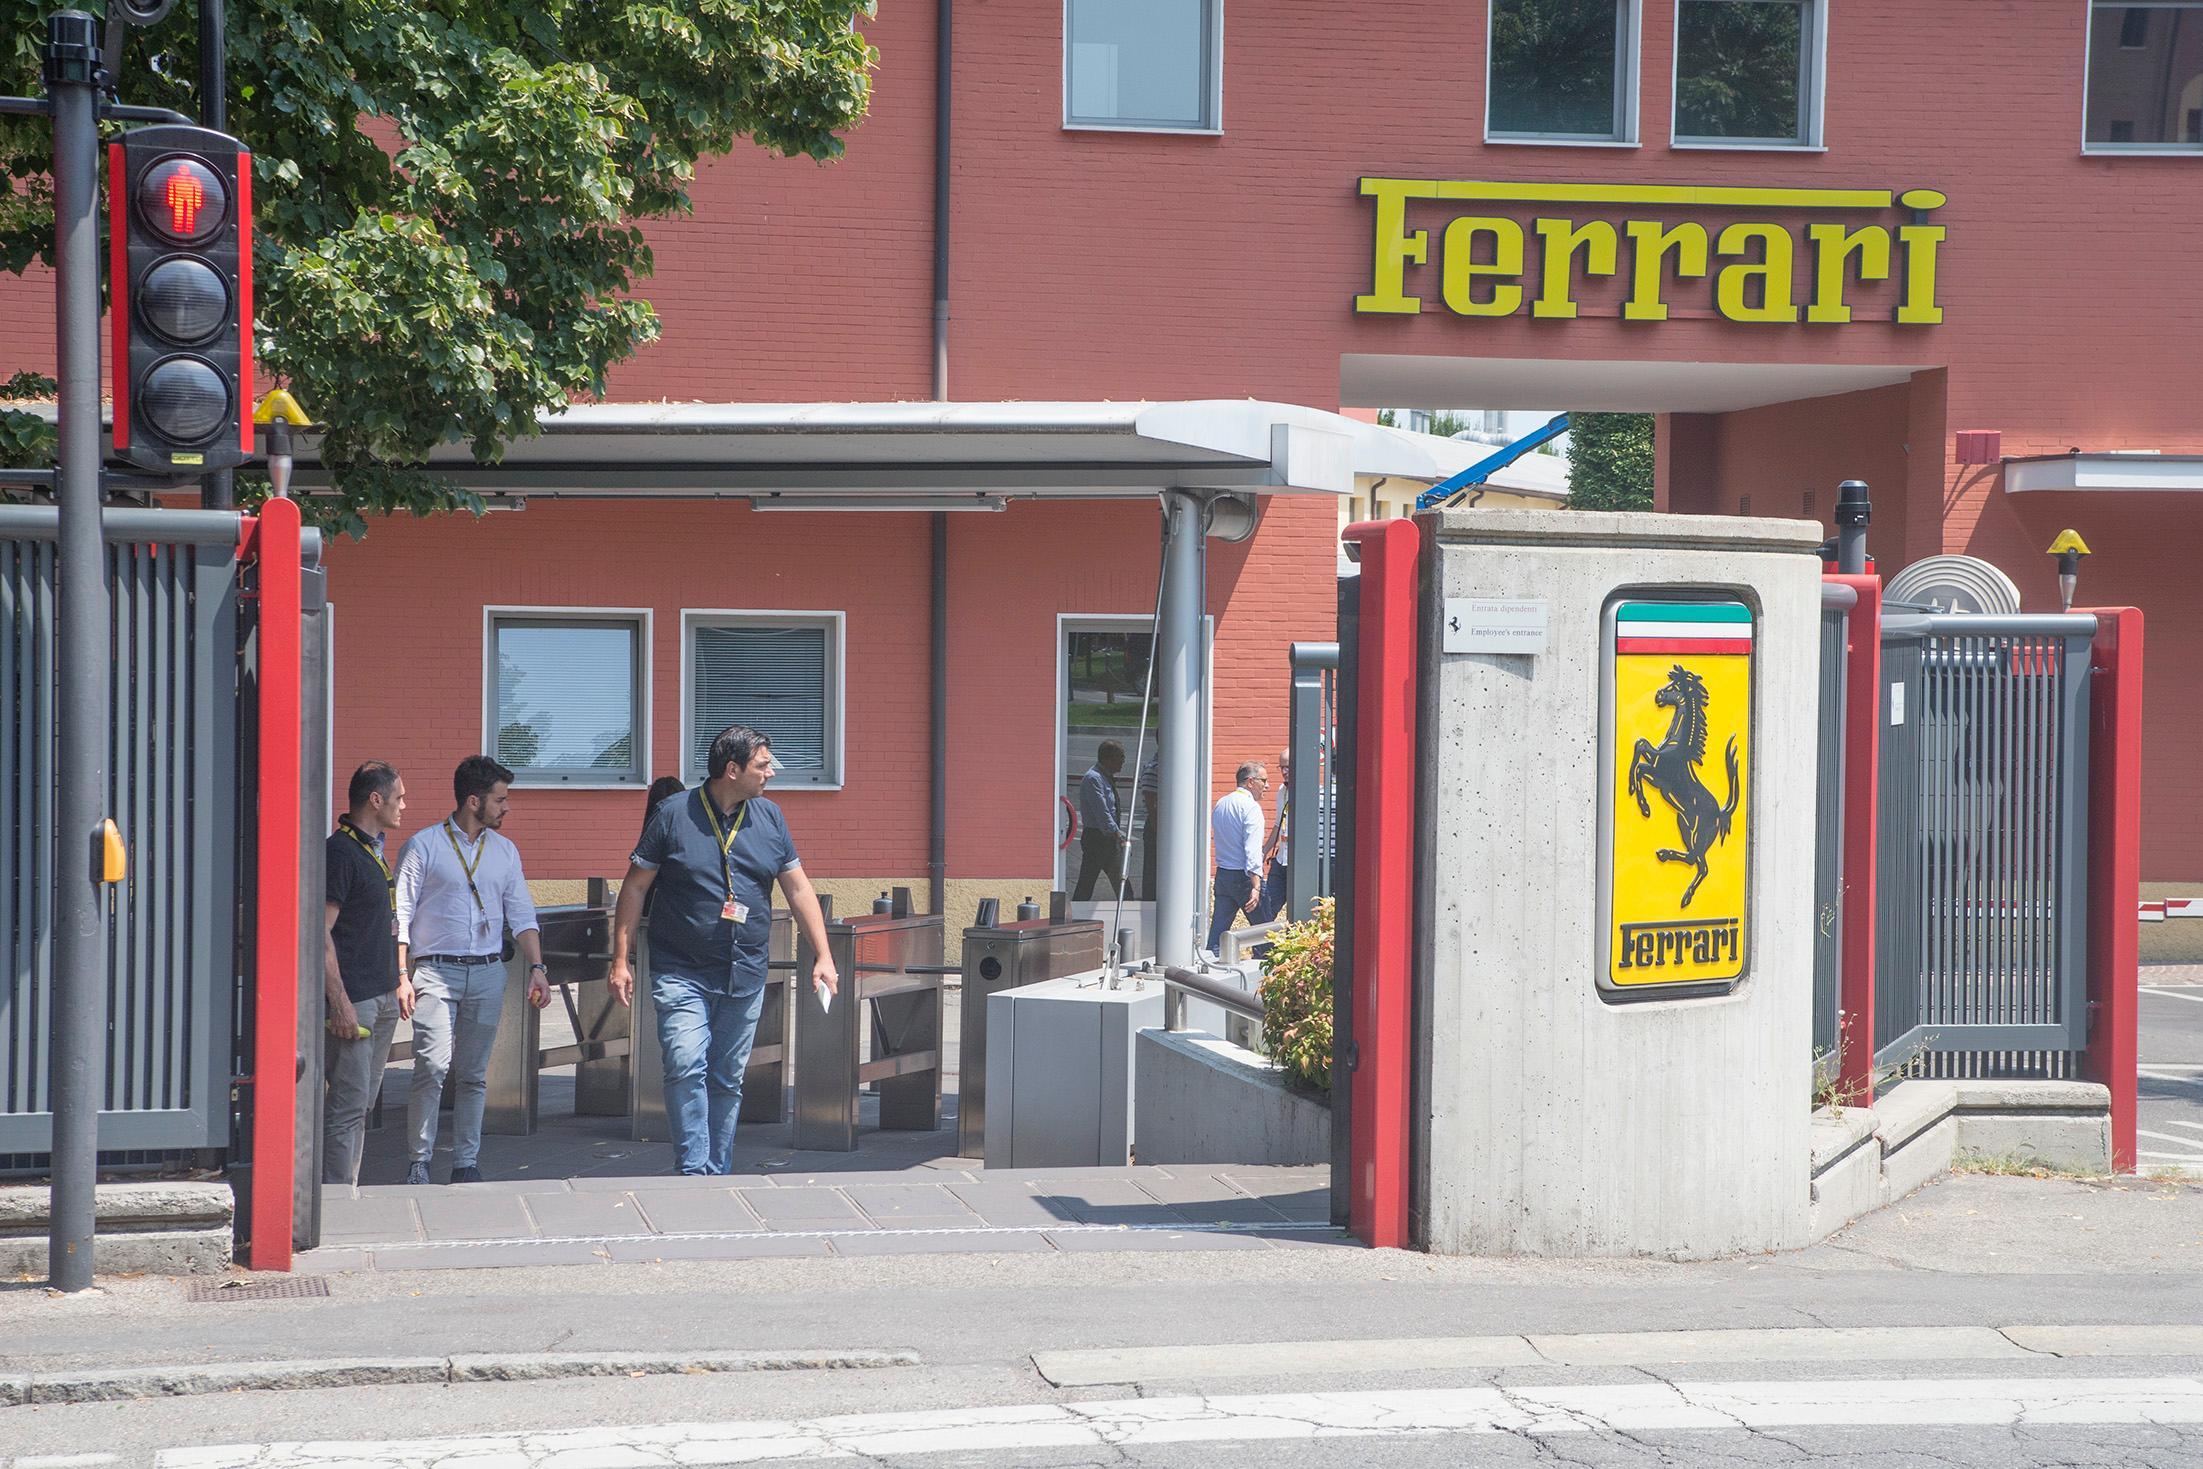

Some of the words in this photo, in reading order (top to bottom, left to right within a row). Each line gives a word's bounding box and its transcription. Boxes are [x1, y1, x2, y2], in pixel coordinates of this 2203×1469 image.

[1354, 176, 1947, 325] Ferrari
[1471, 604, 1498, 612] Entrata
[1471, 627, 1510, 637] Employee's
[1618, 918, 1739, 968] Ferrari
